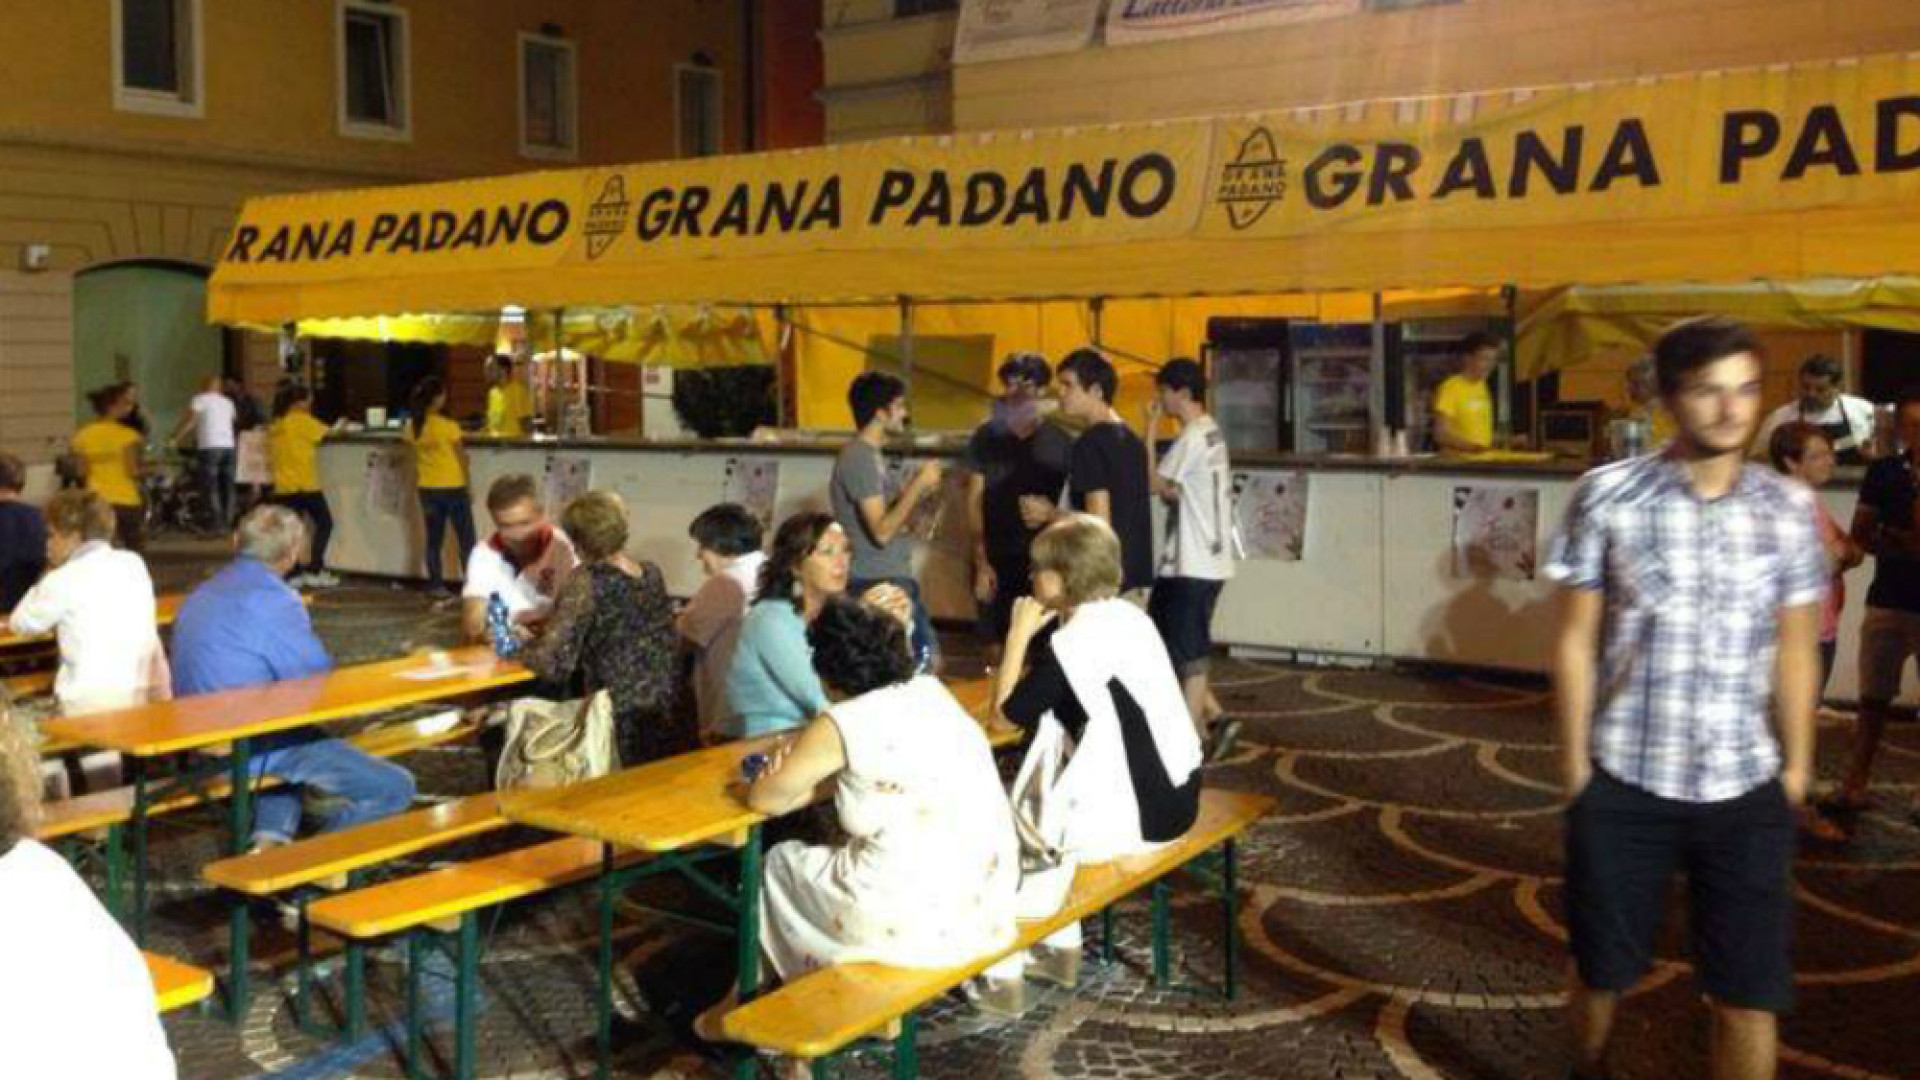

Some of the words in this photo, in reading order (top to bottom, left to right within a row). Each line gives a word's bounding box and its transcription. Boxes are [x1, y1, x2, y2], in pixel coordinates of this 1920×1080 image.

[635, 174, 843, 243] GRANA
[868, 151, 1177, 228] PADANO
[1302, 117, 1661, 211] GRANA
[1718, 94, 1920, 185] PAD
[226, 218, 356, 263] RANA
[363, 198, 571, 254] PADANO
